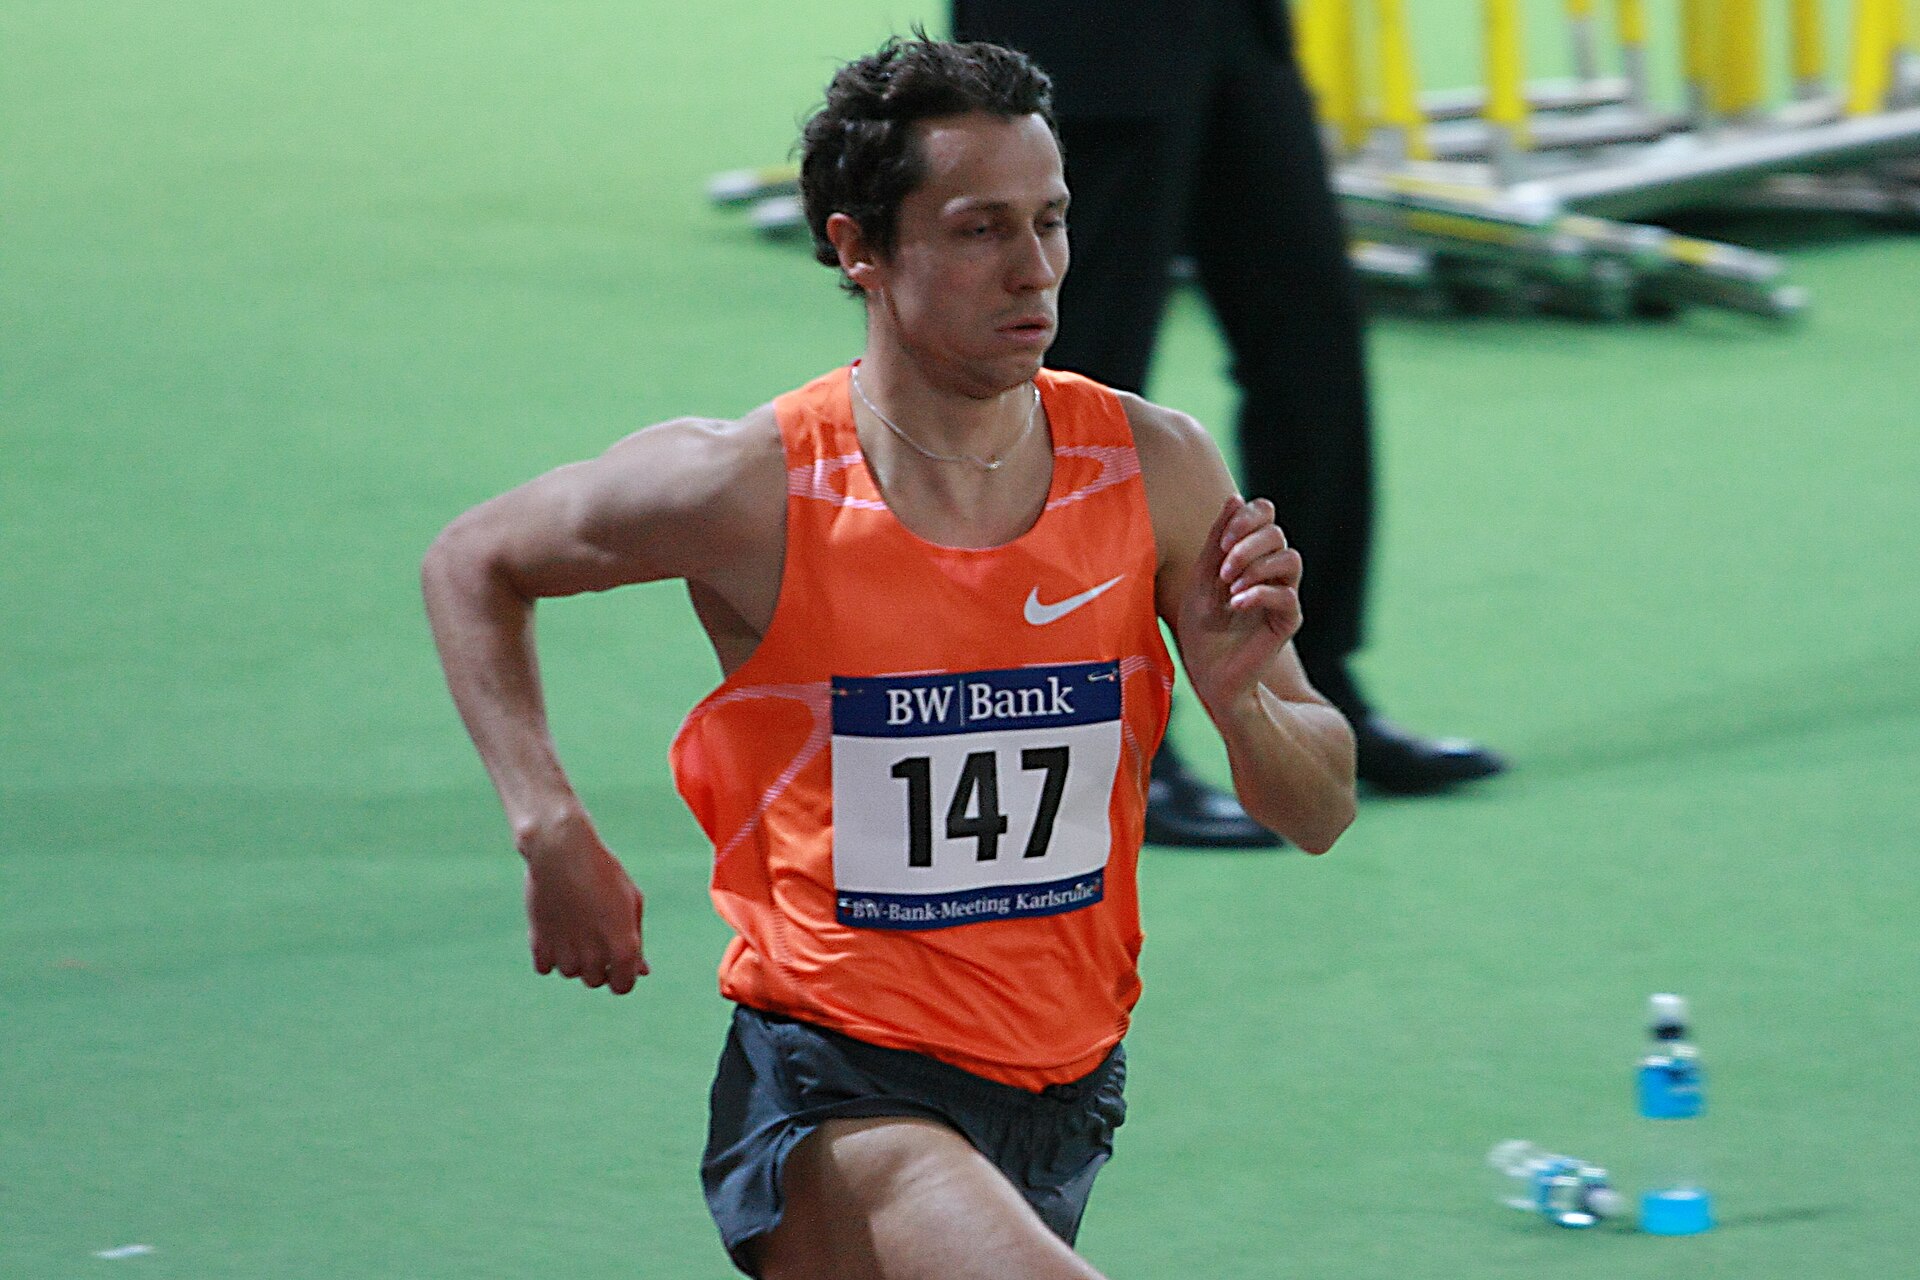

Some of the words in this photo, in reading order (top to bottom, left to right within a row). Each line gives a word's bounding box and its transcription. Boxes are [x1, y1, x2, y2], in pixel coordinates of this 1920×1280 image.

[887, 687, 954, 725] BW
[967, 677, 1075, 720] Bank
[891, 746, 1069, 867] 147
[852, 898, 1010, 921] BW-Bank-Meeting
[1015, 884, 1094, 910] Karlsruhe
